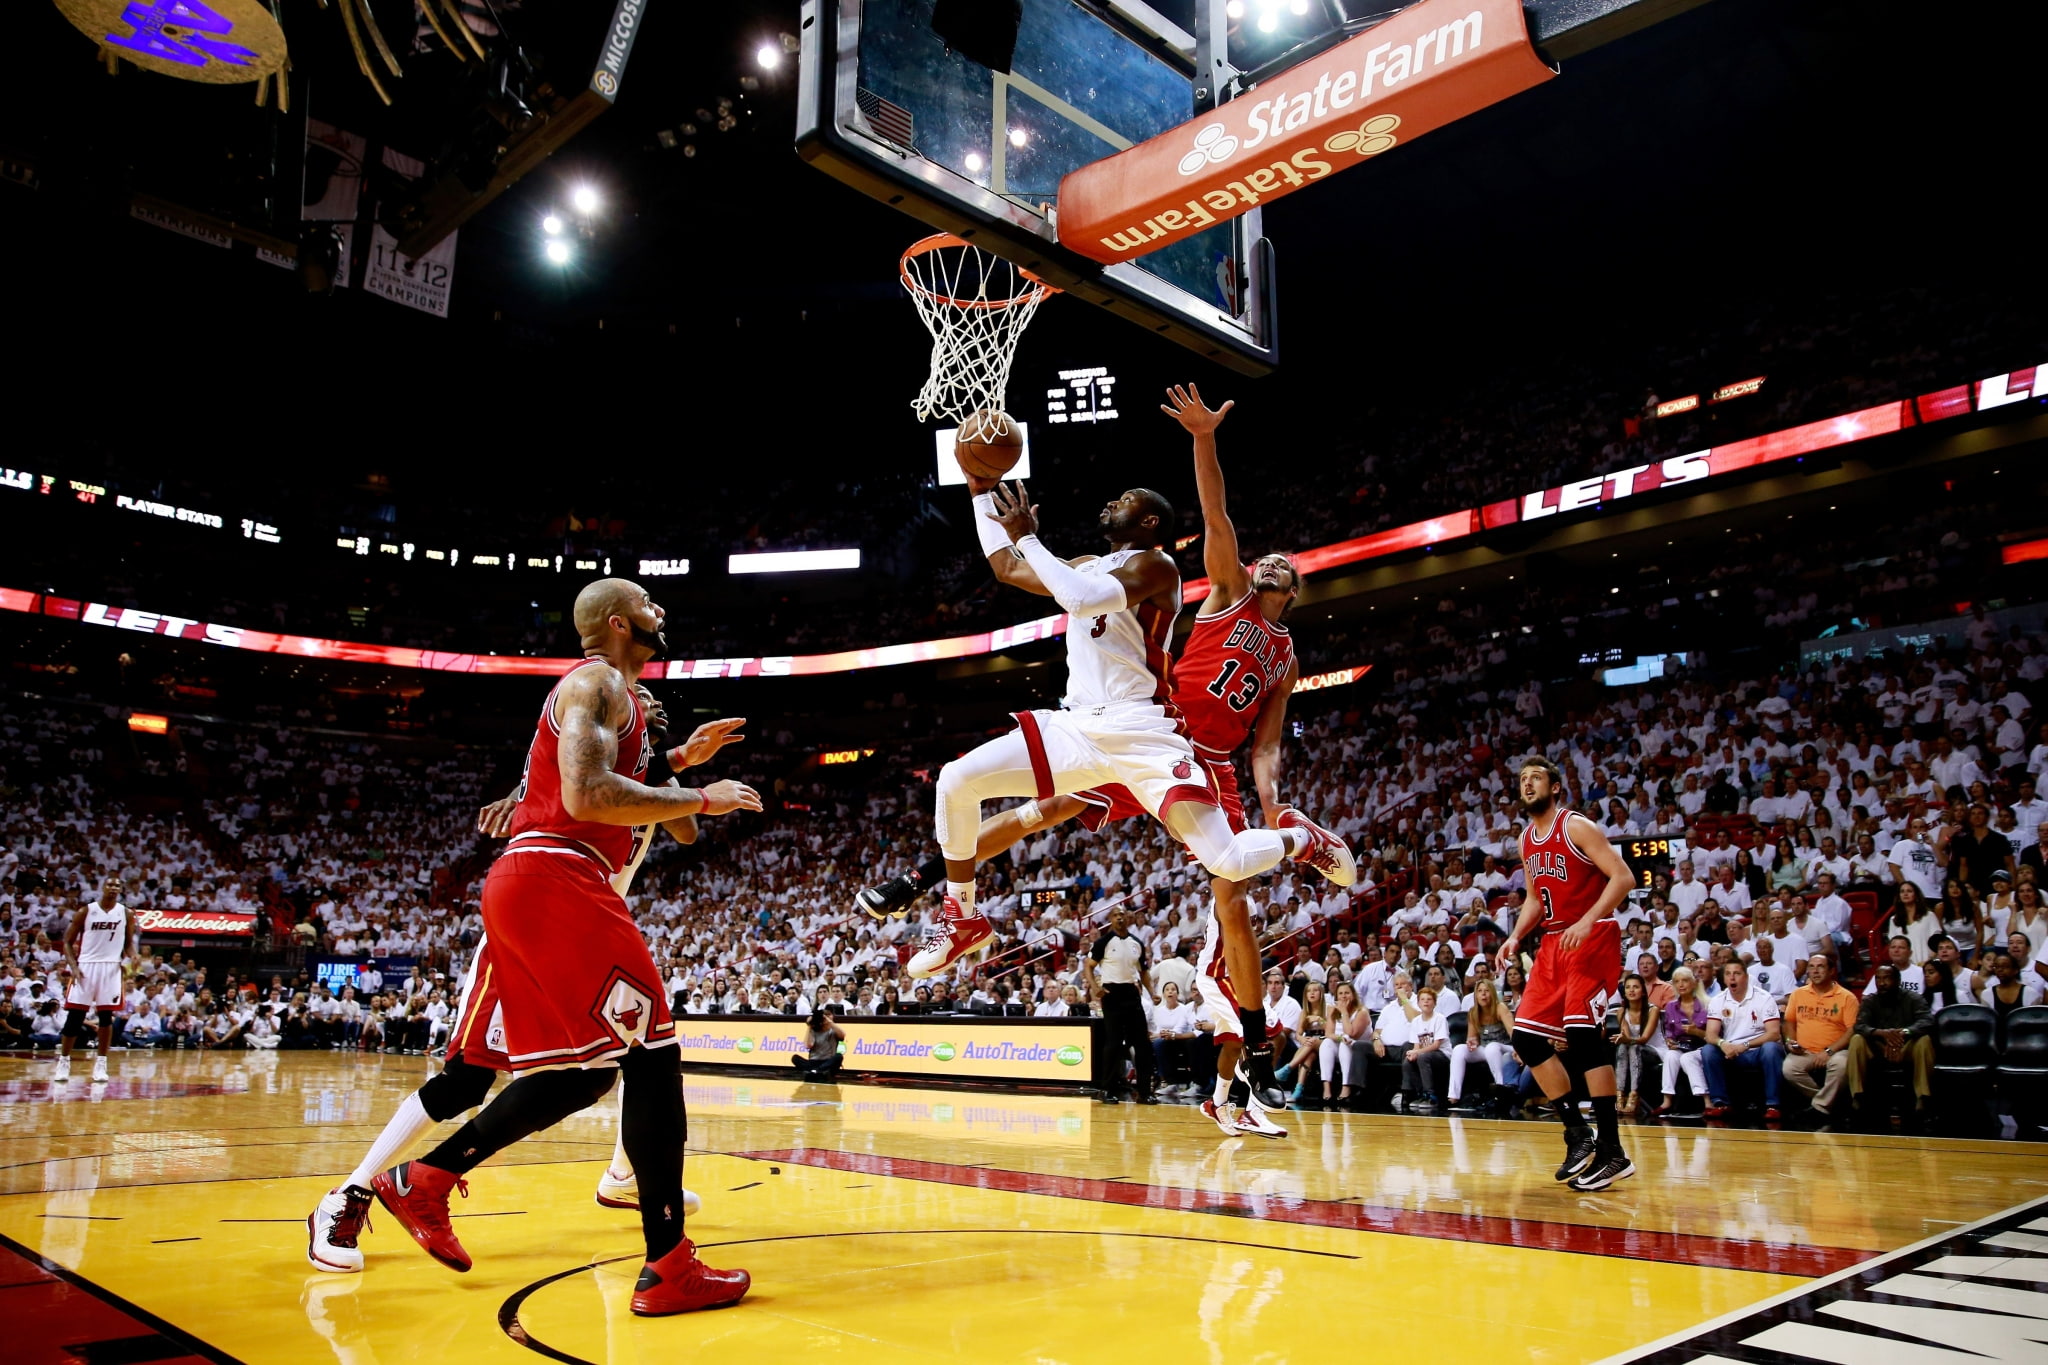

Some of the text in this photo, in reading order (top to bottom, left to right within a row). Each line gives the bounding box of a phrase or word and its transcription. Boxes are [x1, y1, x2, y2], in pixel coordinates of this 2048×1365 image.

[422, 261, 448, 288] 12
[369, 277, 445, 312] CHAMPIONS
[116, 495, 223, 528] PLAYER STATS
[639, 559, 690, 575] BULLS
[1223, 618, 1286, 691] BULLS
[1206, 658, 1261, 712] 13
[1631, 840, 1668, 857] 5:39
[1643, 870, 1653, 886] 3
[91, 920, 122, 931] HEAT
[134, 909, 250, 932] Budweiser
[108, 932, 116, 942] 1
[317, 963, 357, 977] DJ IRIE
